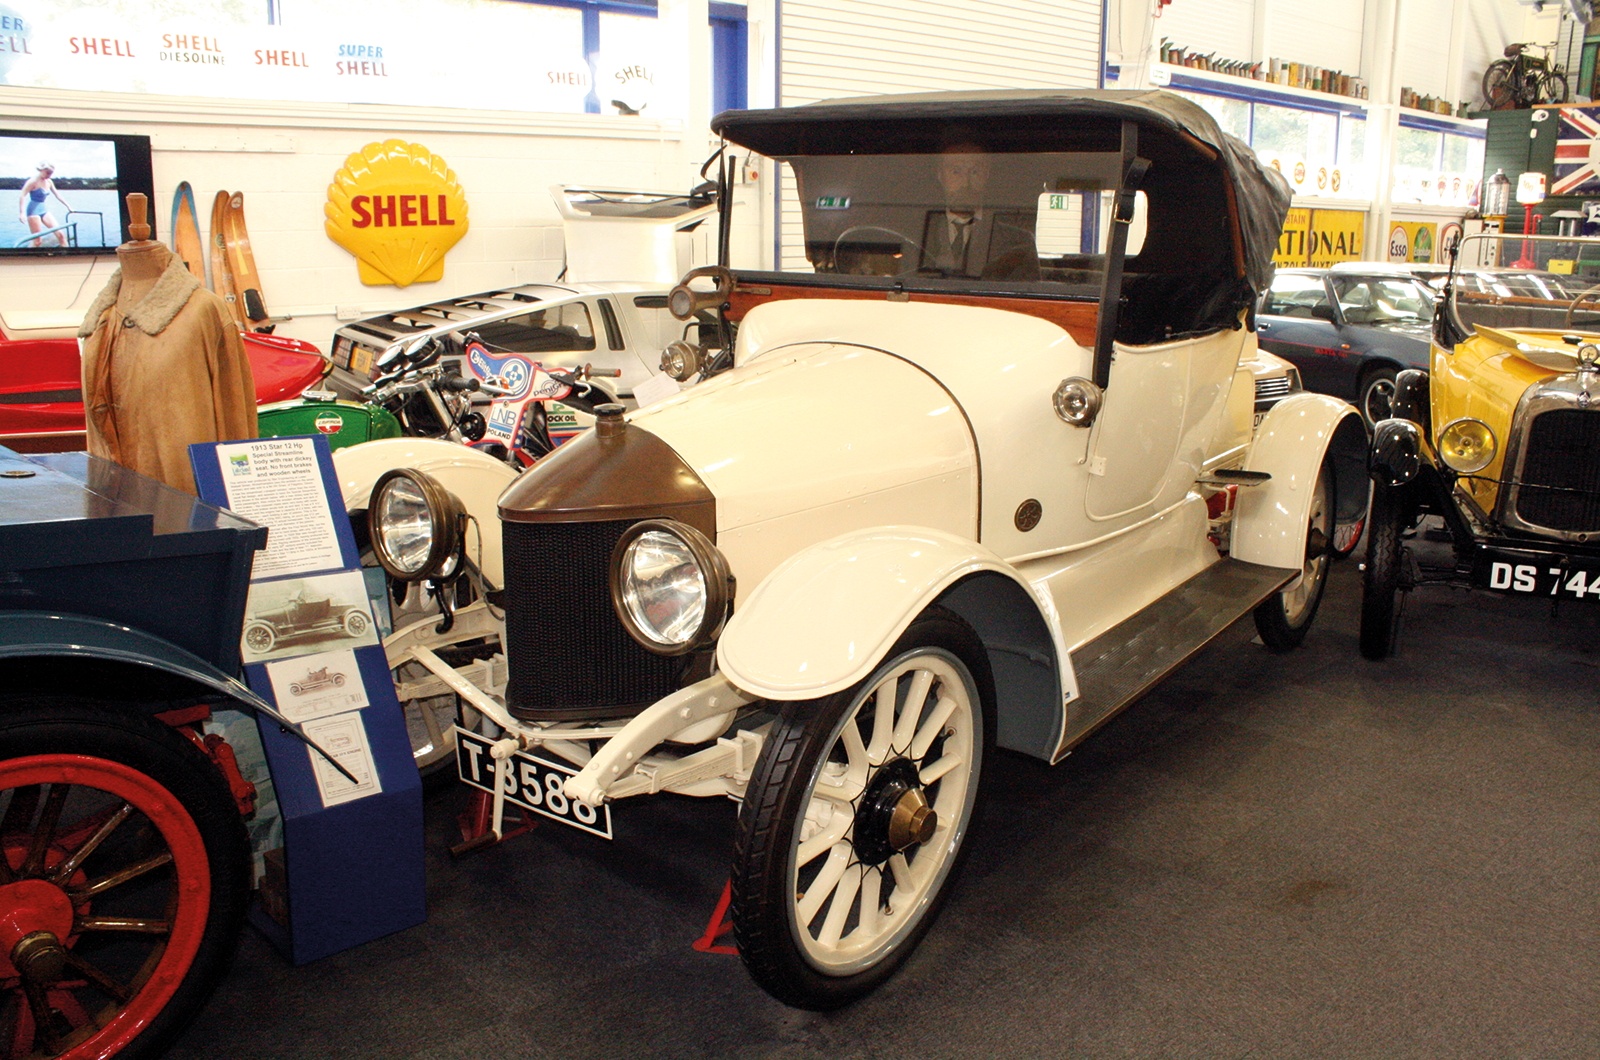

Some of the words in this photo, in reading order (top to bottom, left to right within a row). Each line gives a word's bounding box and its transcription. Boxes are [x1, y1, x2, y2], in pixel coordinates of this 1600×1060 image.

[69, 36, 136, 58] SHELL
[162, 33, 222, 53] SHELL
[338, 43, 383, 58] SUPER
[159, 51, 226, 66] DIESOLINE
[254, 49, 310, 68] SHELL
[336, 60, 389, 77] SHELL
[614, 65, 655, 86] SHELL
[350, 194, 456, 229] SHELL
[490, 406, 516, 426] LNB
[487, 428, 511, 440] POLAND
[1490, 562, 1537, 592] DS
